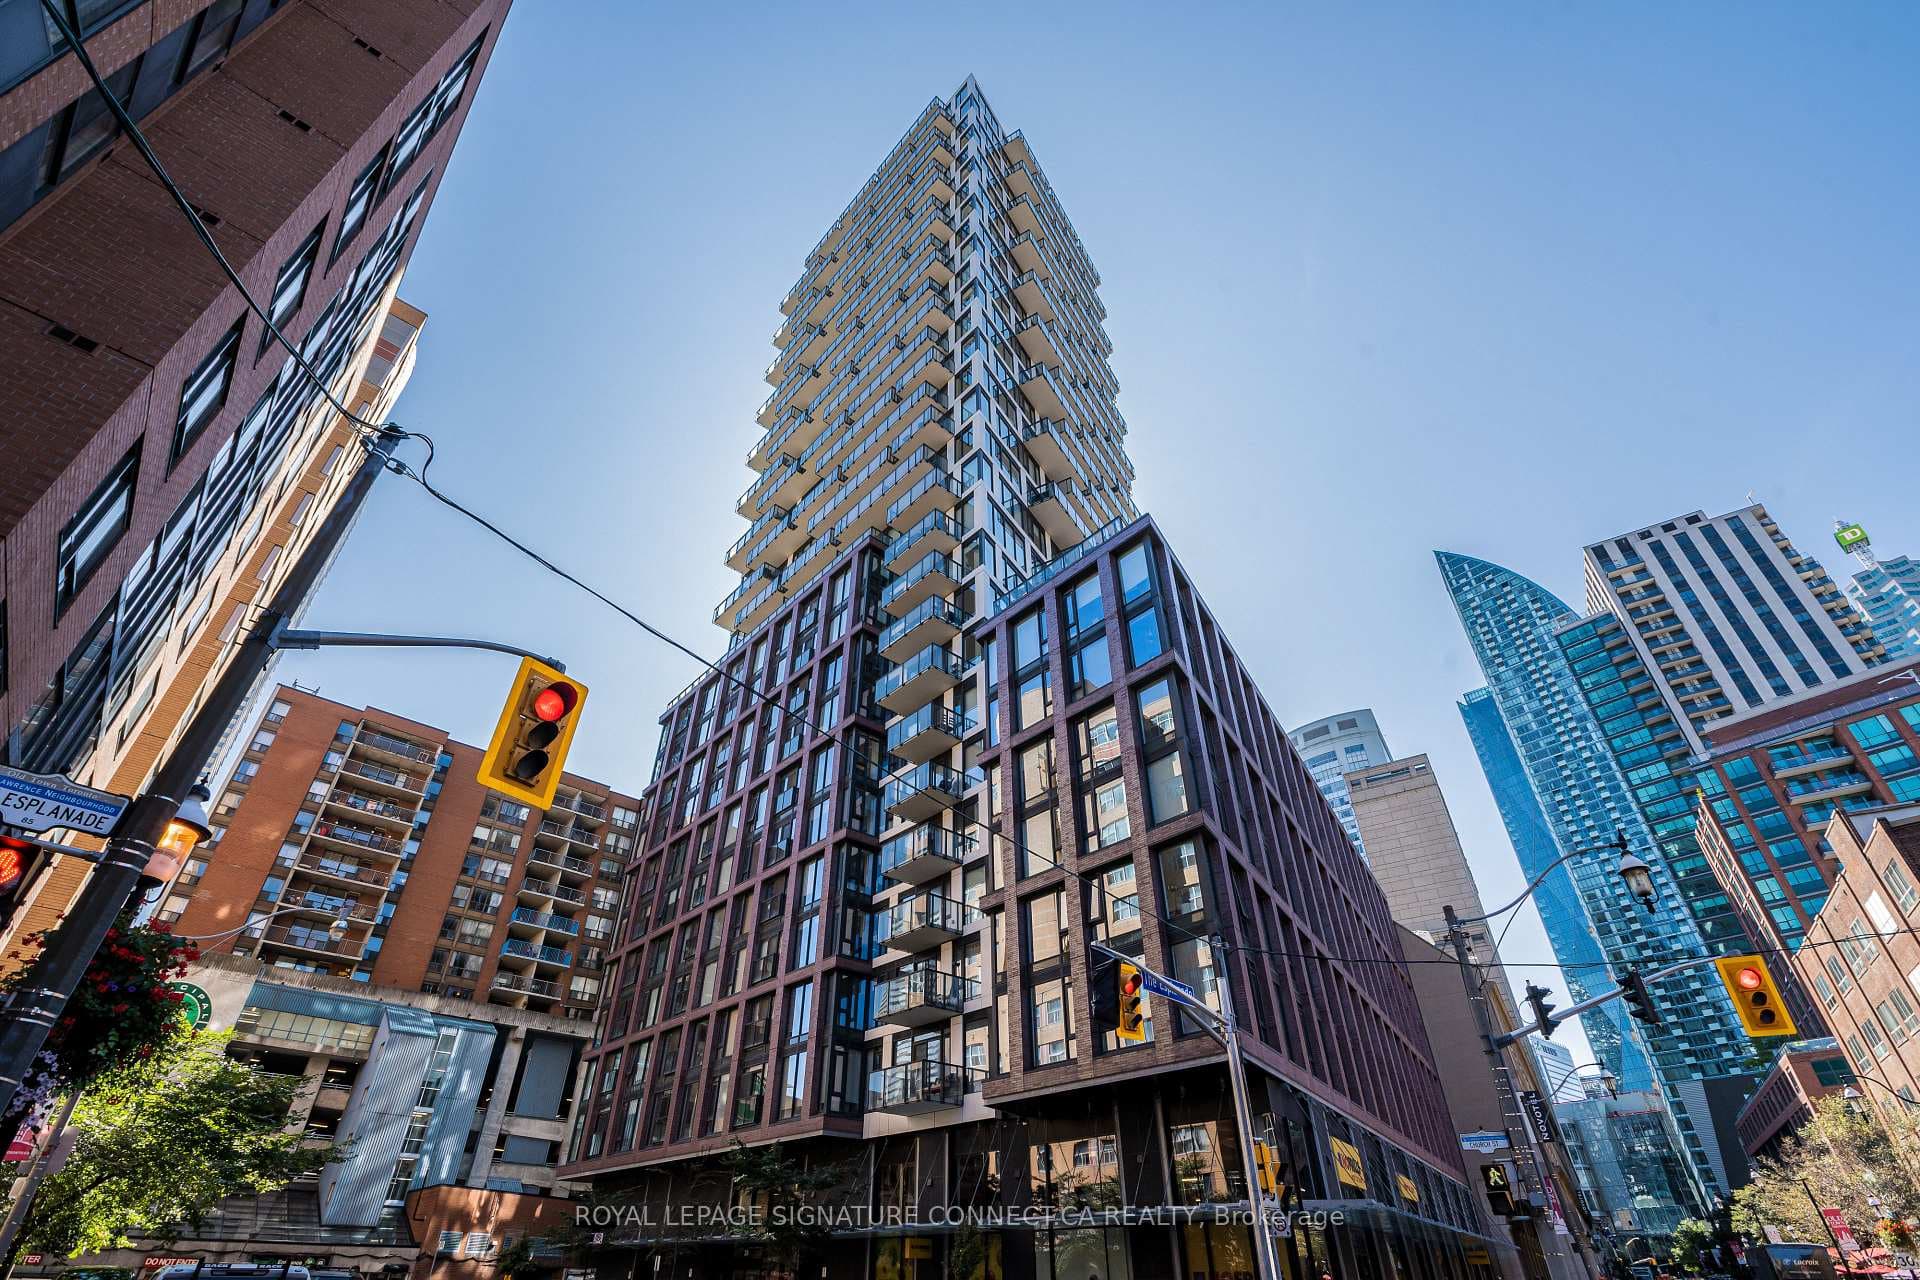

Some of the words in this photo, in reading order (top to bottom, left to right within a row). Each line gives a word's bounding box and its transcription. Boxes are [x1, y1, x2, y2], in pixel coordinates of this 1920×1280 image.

[1838, 528, 1861, 541] TD
[8, 770, 26, 780] Old
[31, 776, 57, 789] Town
[0, 779, 42, 795] AWRENCE
[45, 789, 115, 814] NEIGHBOURHOOD
[1, 792, 110, 831] ESPLANADE
[20, 816, 34, 825] 85
[1529, 1093, 1550, 1140] NOVOTEL
[24, 1255, 42, 1264] TER
[145, 1257, 158, 1265] DO
[158, 1258, 176, 1266] NOT
